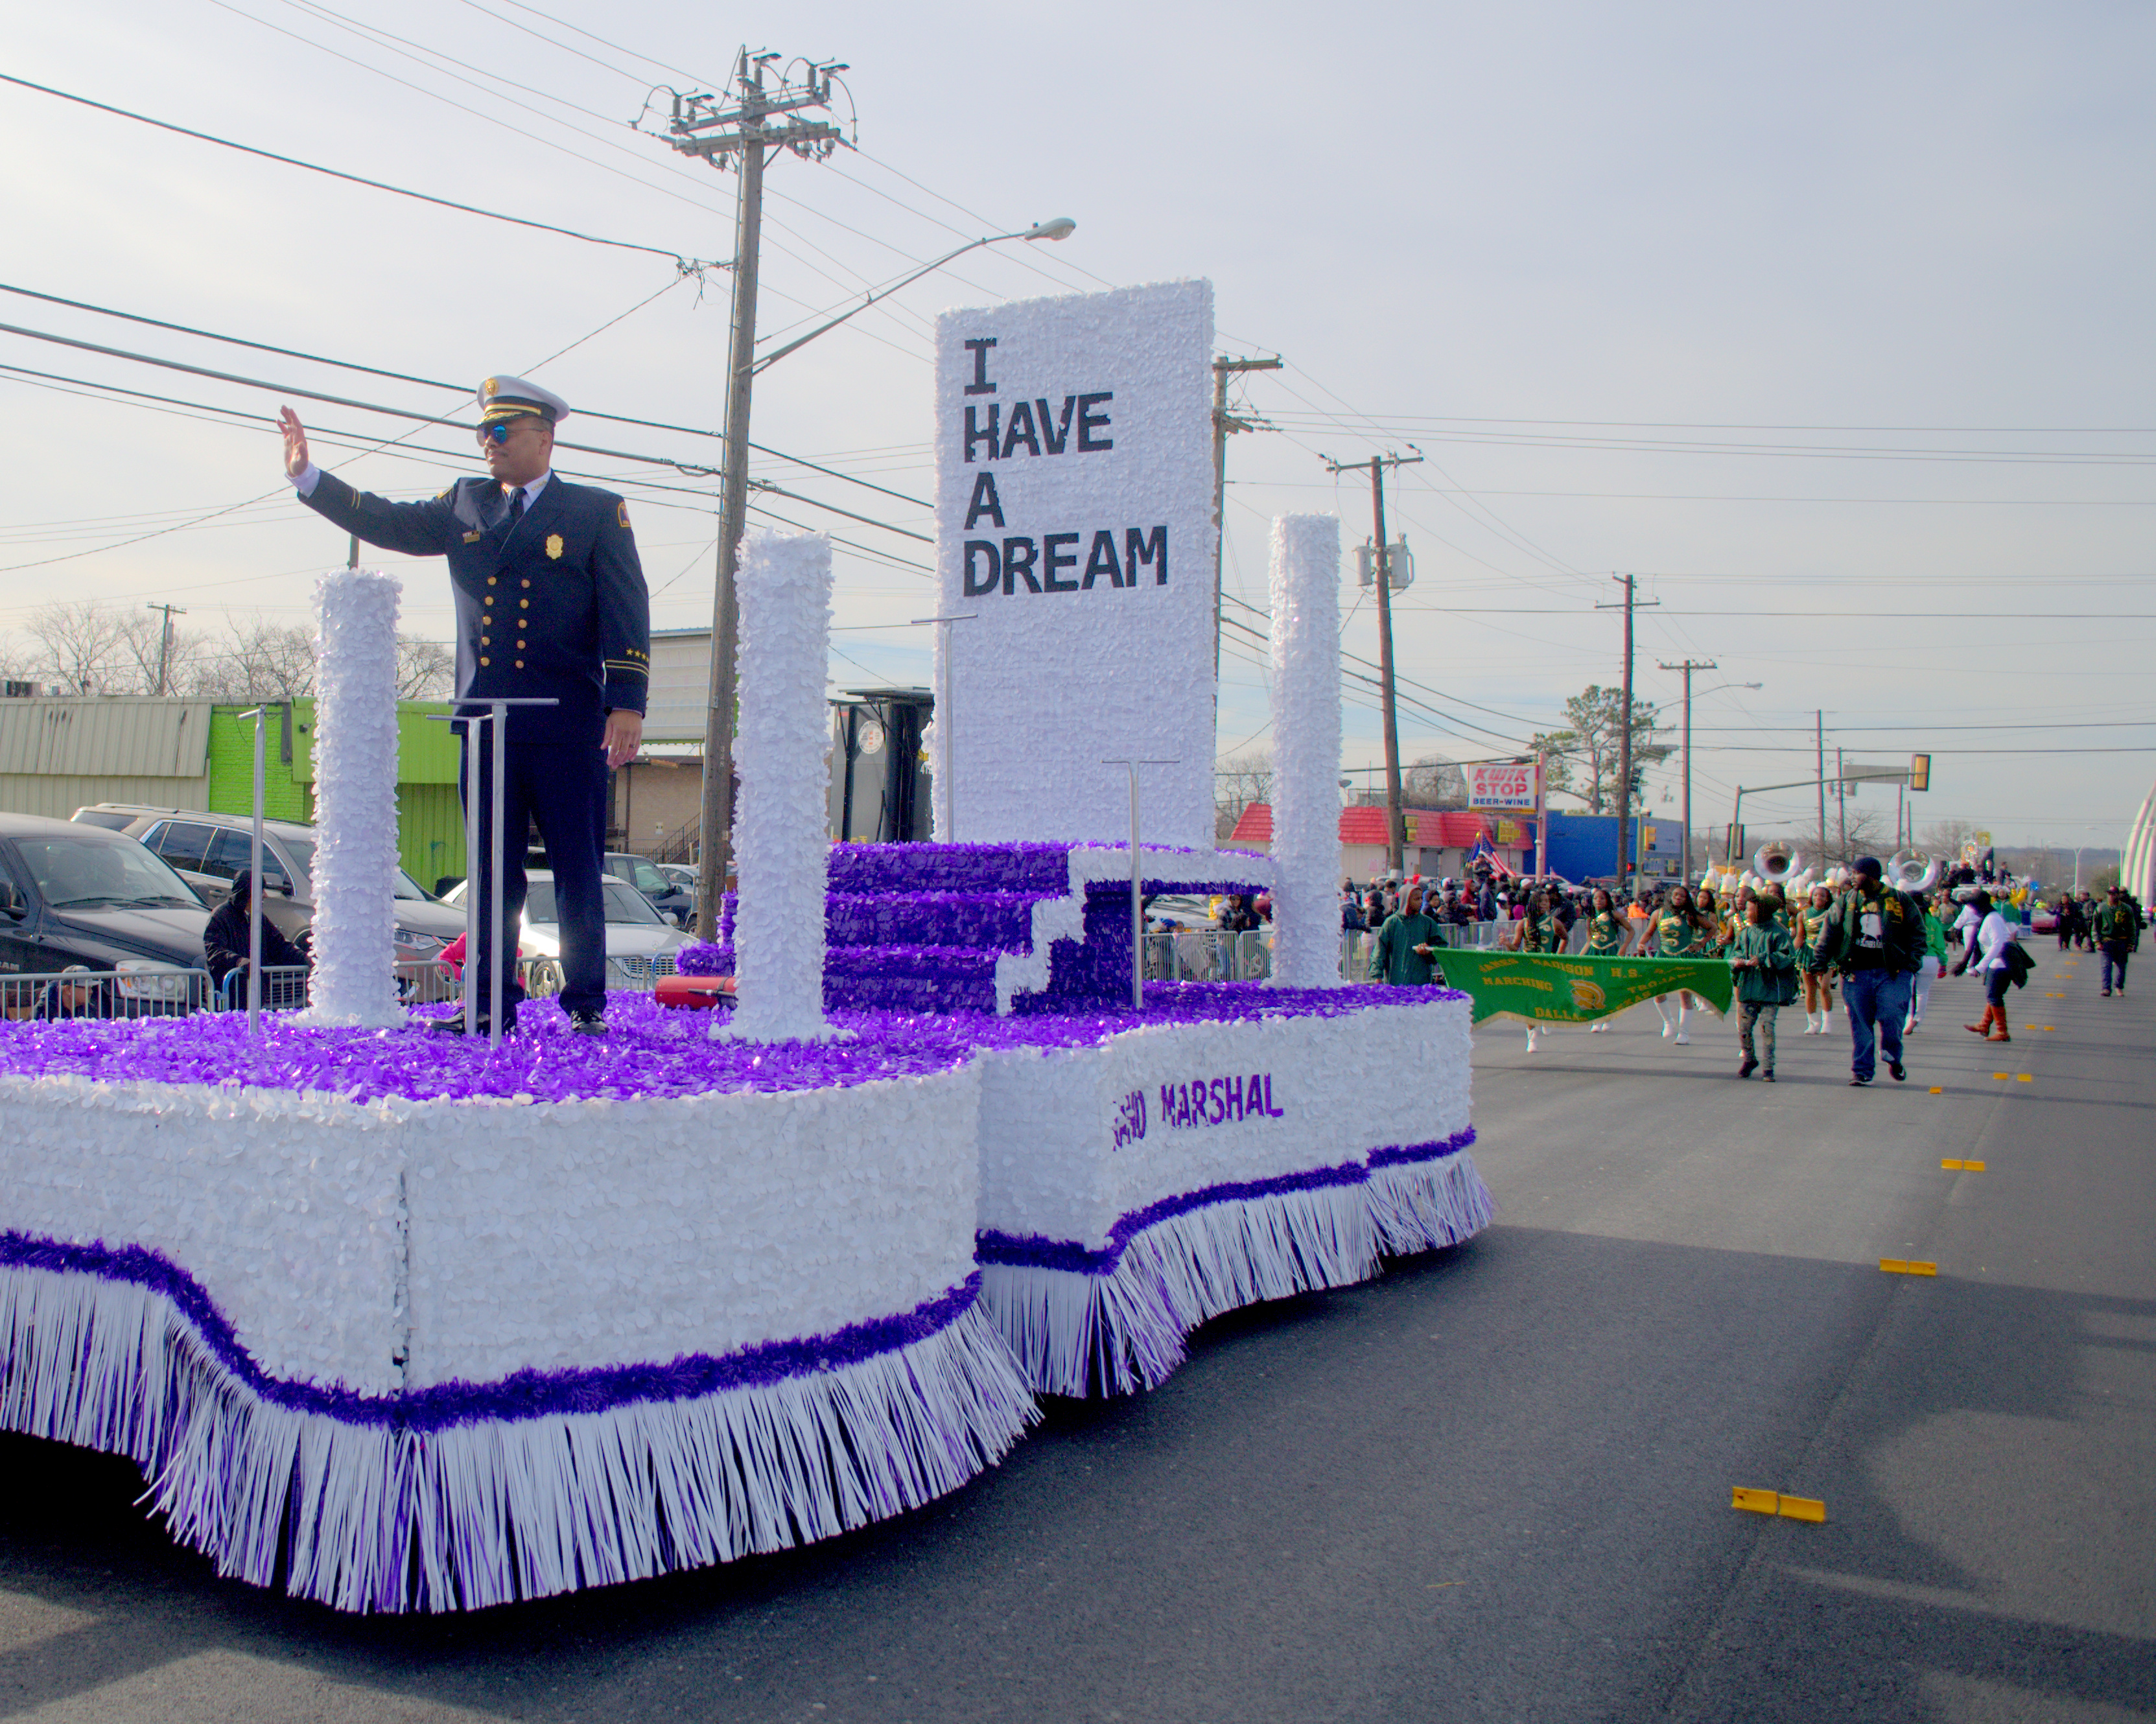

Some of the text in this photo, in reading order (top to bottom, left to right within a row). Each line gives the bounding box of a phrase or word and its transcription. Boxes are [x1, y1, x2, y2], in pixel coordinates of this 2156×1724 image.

[964, 338, 997, 395] I
[964, 391, 1113, 463] HAVE
[963, 472, 1005, 530] A
[963, 526, 1167, 597] DREAM
[1476, 782, 1528, 797] STOP
[0, 961, 20, 972] AM
[1482, 977, 1554, 992] MARCHING
[1531, 958, 1595, 976] MADISON
[1160, 1073, 1284, 1130] MARSHAL
